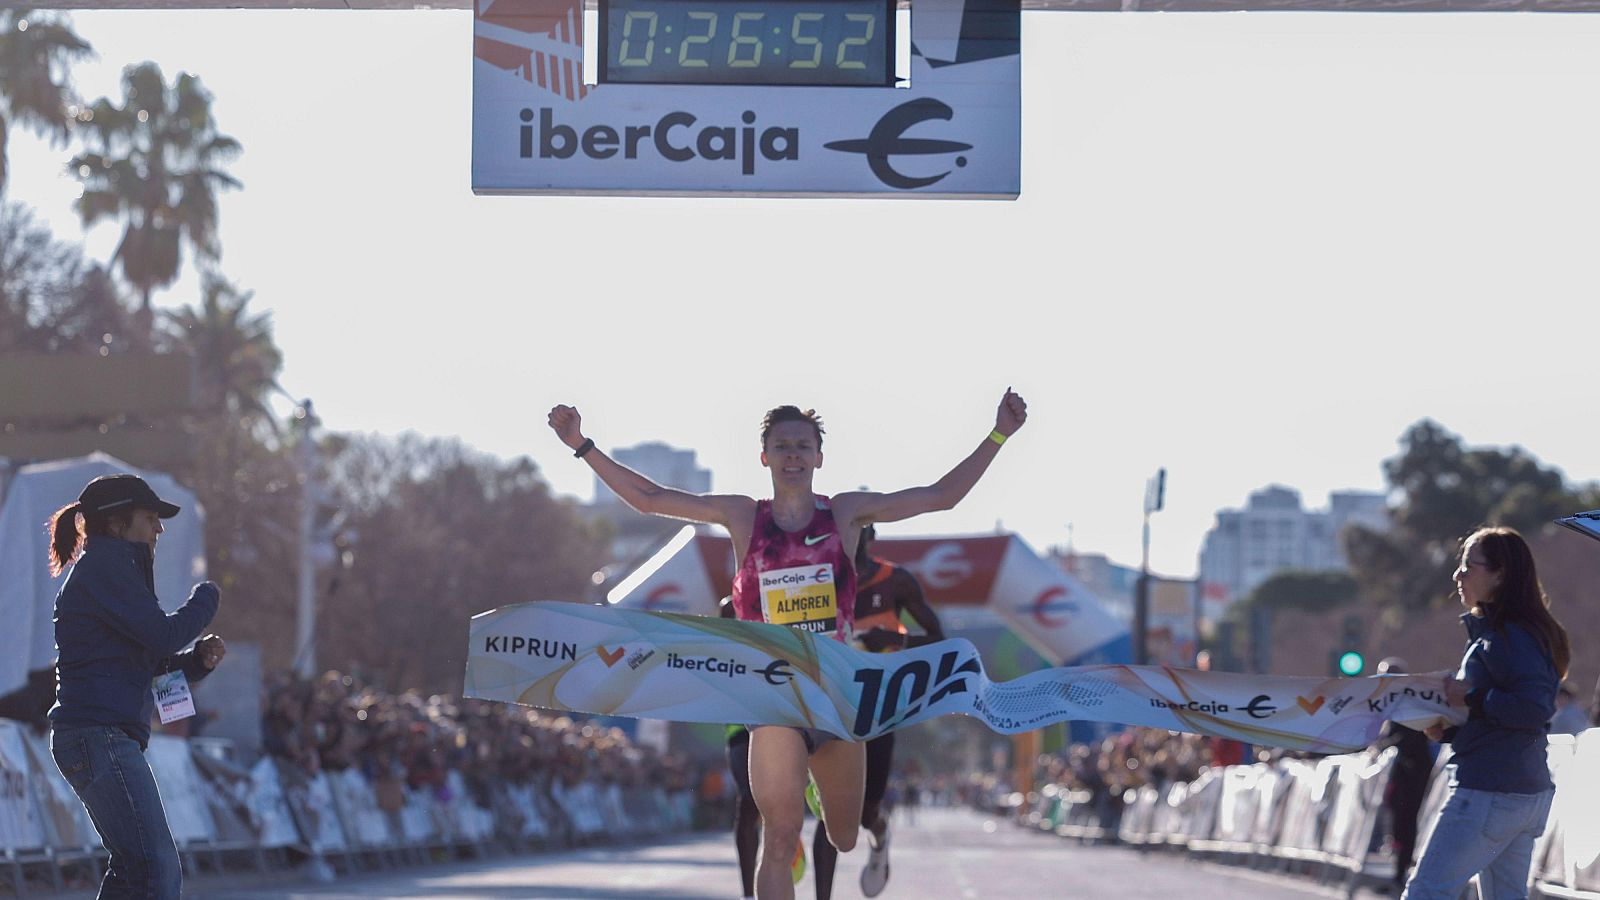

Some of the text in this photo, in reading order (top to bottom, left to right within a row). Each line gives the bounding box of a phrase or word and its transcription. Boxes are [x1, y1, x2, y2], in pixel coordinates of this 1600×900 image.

[618, 11, 875, 69] 0:26:52
[519, 107, 799, 175] iberCaja
[762, 573, 805, 586] iberCaja
[777, 595, 829, 613] ALMGREN
[802, 612, 808, 620] 2
[485, 636, 577, 661] KIPRUN
[667, 653, 746, 678] iberCaja
[853, 651, 981, 737] 10K
[1150, 698, 1228, 715] iberCaja
